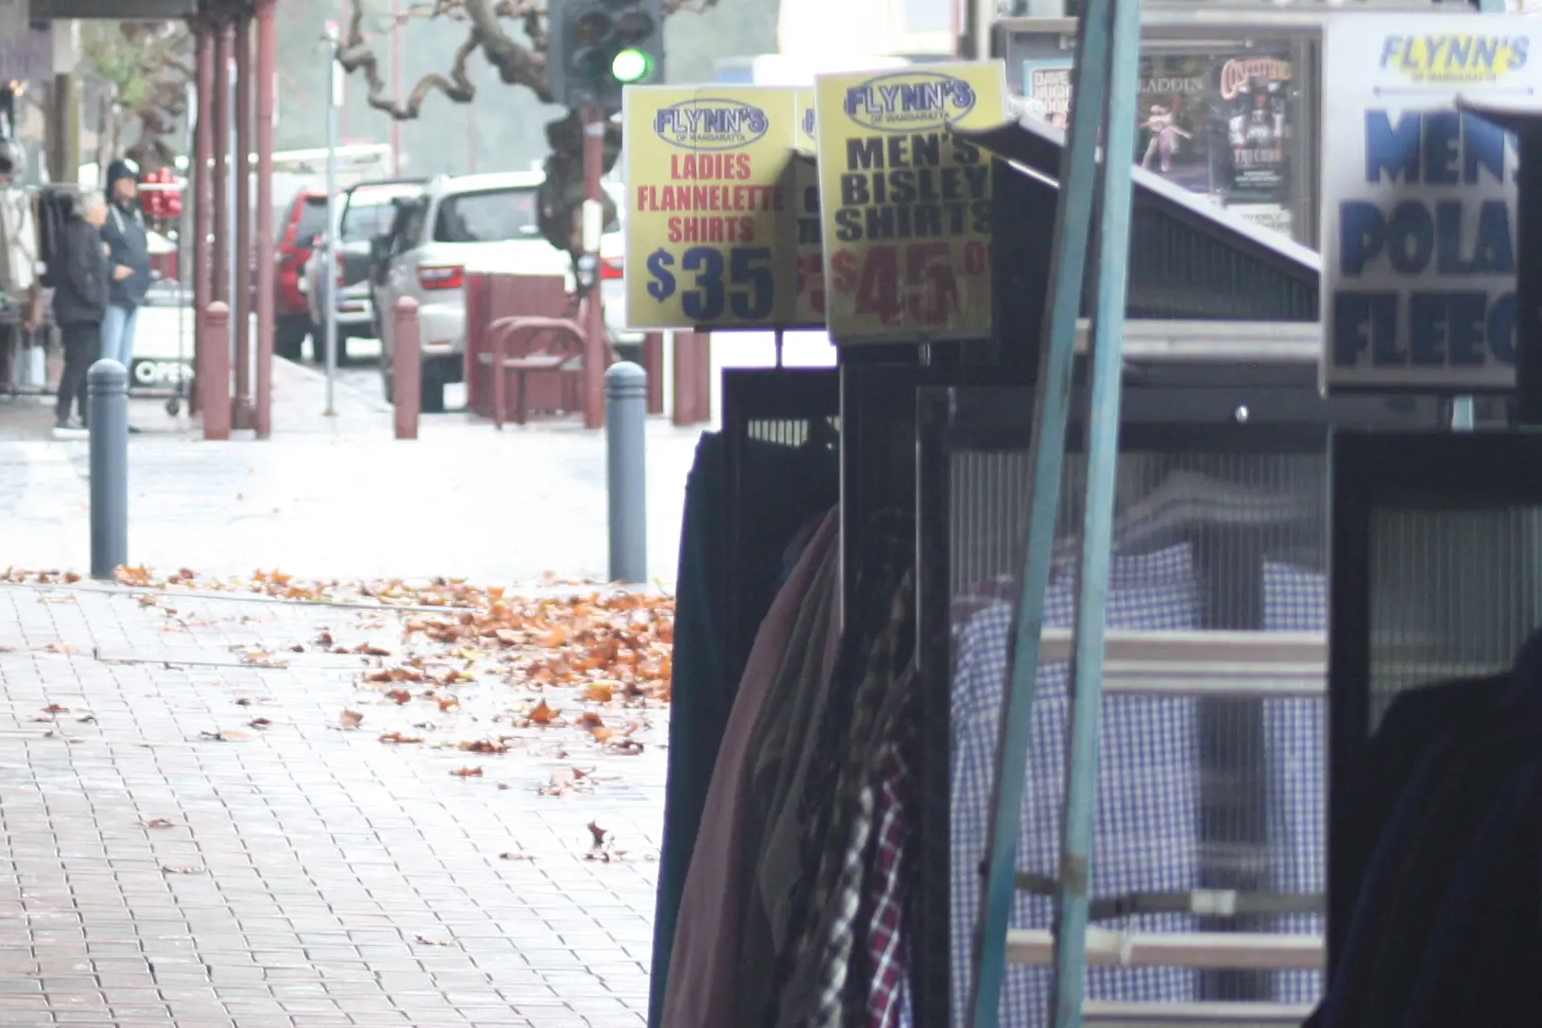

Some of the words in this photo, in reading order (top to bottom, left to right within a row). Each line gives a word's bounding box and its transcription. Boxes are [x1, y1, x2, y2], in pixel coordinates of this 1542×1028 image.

[1379, 34, 1530, 69] FLYNN'S
[845, 80, 974, 115] FLYNN'S
[655, 106, 767, 134] FLYNN'S
[670, 153, 751, 180] LADIES
[846, 133, 980, 170] MEN'S
[637, 185, 785, 212] FLANNELETTE
[840, 166, 989, 205] BISLEY
[667, 216, 756, 243] SHIRTS
[834, 201, 993, 241] SHIRTS
[646, 247, 774, 321] $35
